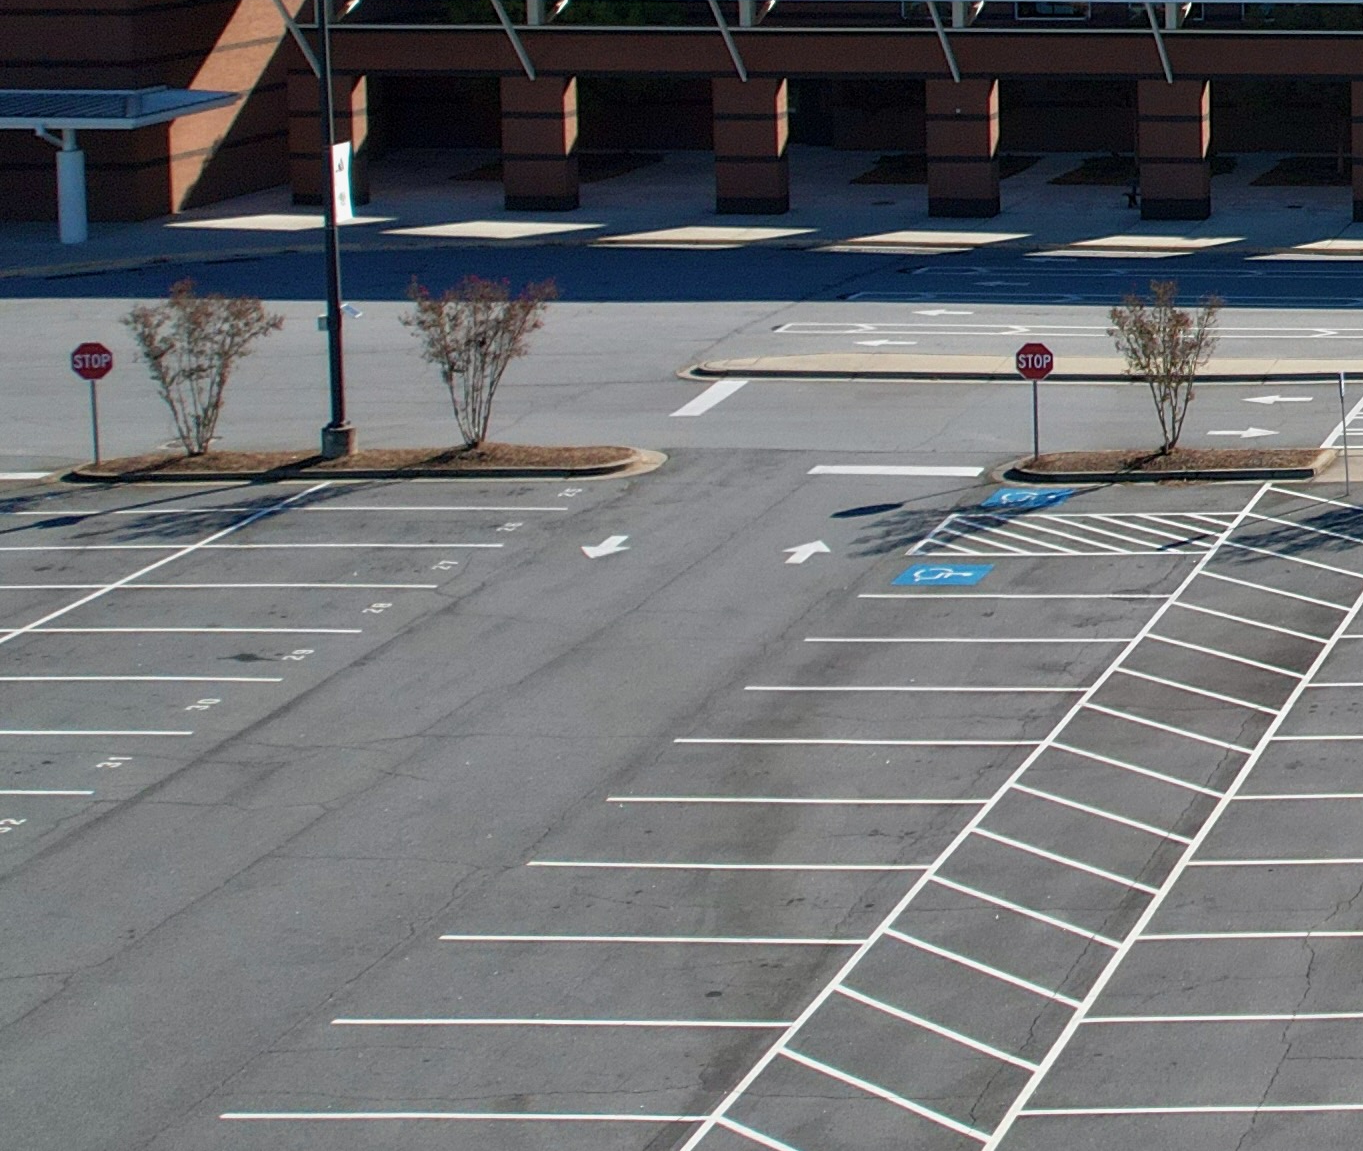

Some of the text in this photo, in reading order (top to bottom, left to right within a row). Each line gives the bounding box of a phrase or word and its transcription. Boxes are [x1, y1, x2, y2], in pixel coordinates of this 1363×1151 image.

[73, 353, 112, 370] STOP
[1018, 353, 1051, 369] STOP
[281, 649, 315, 661] 29
[184, 698, 222, 711] 30
[95, 756, 134, 769] 31
